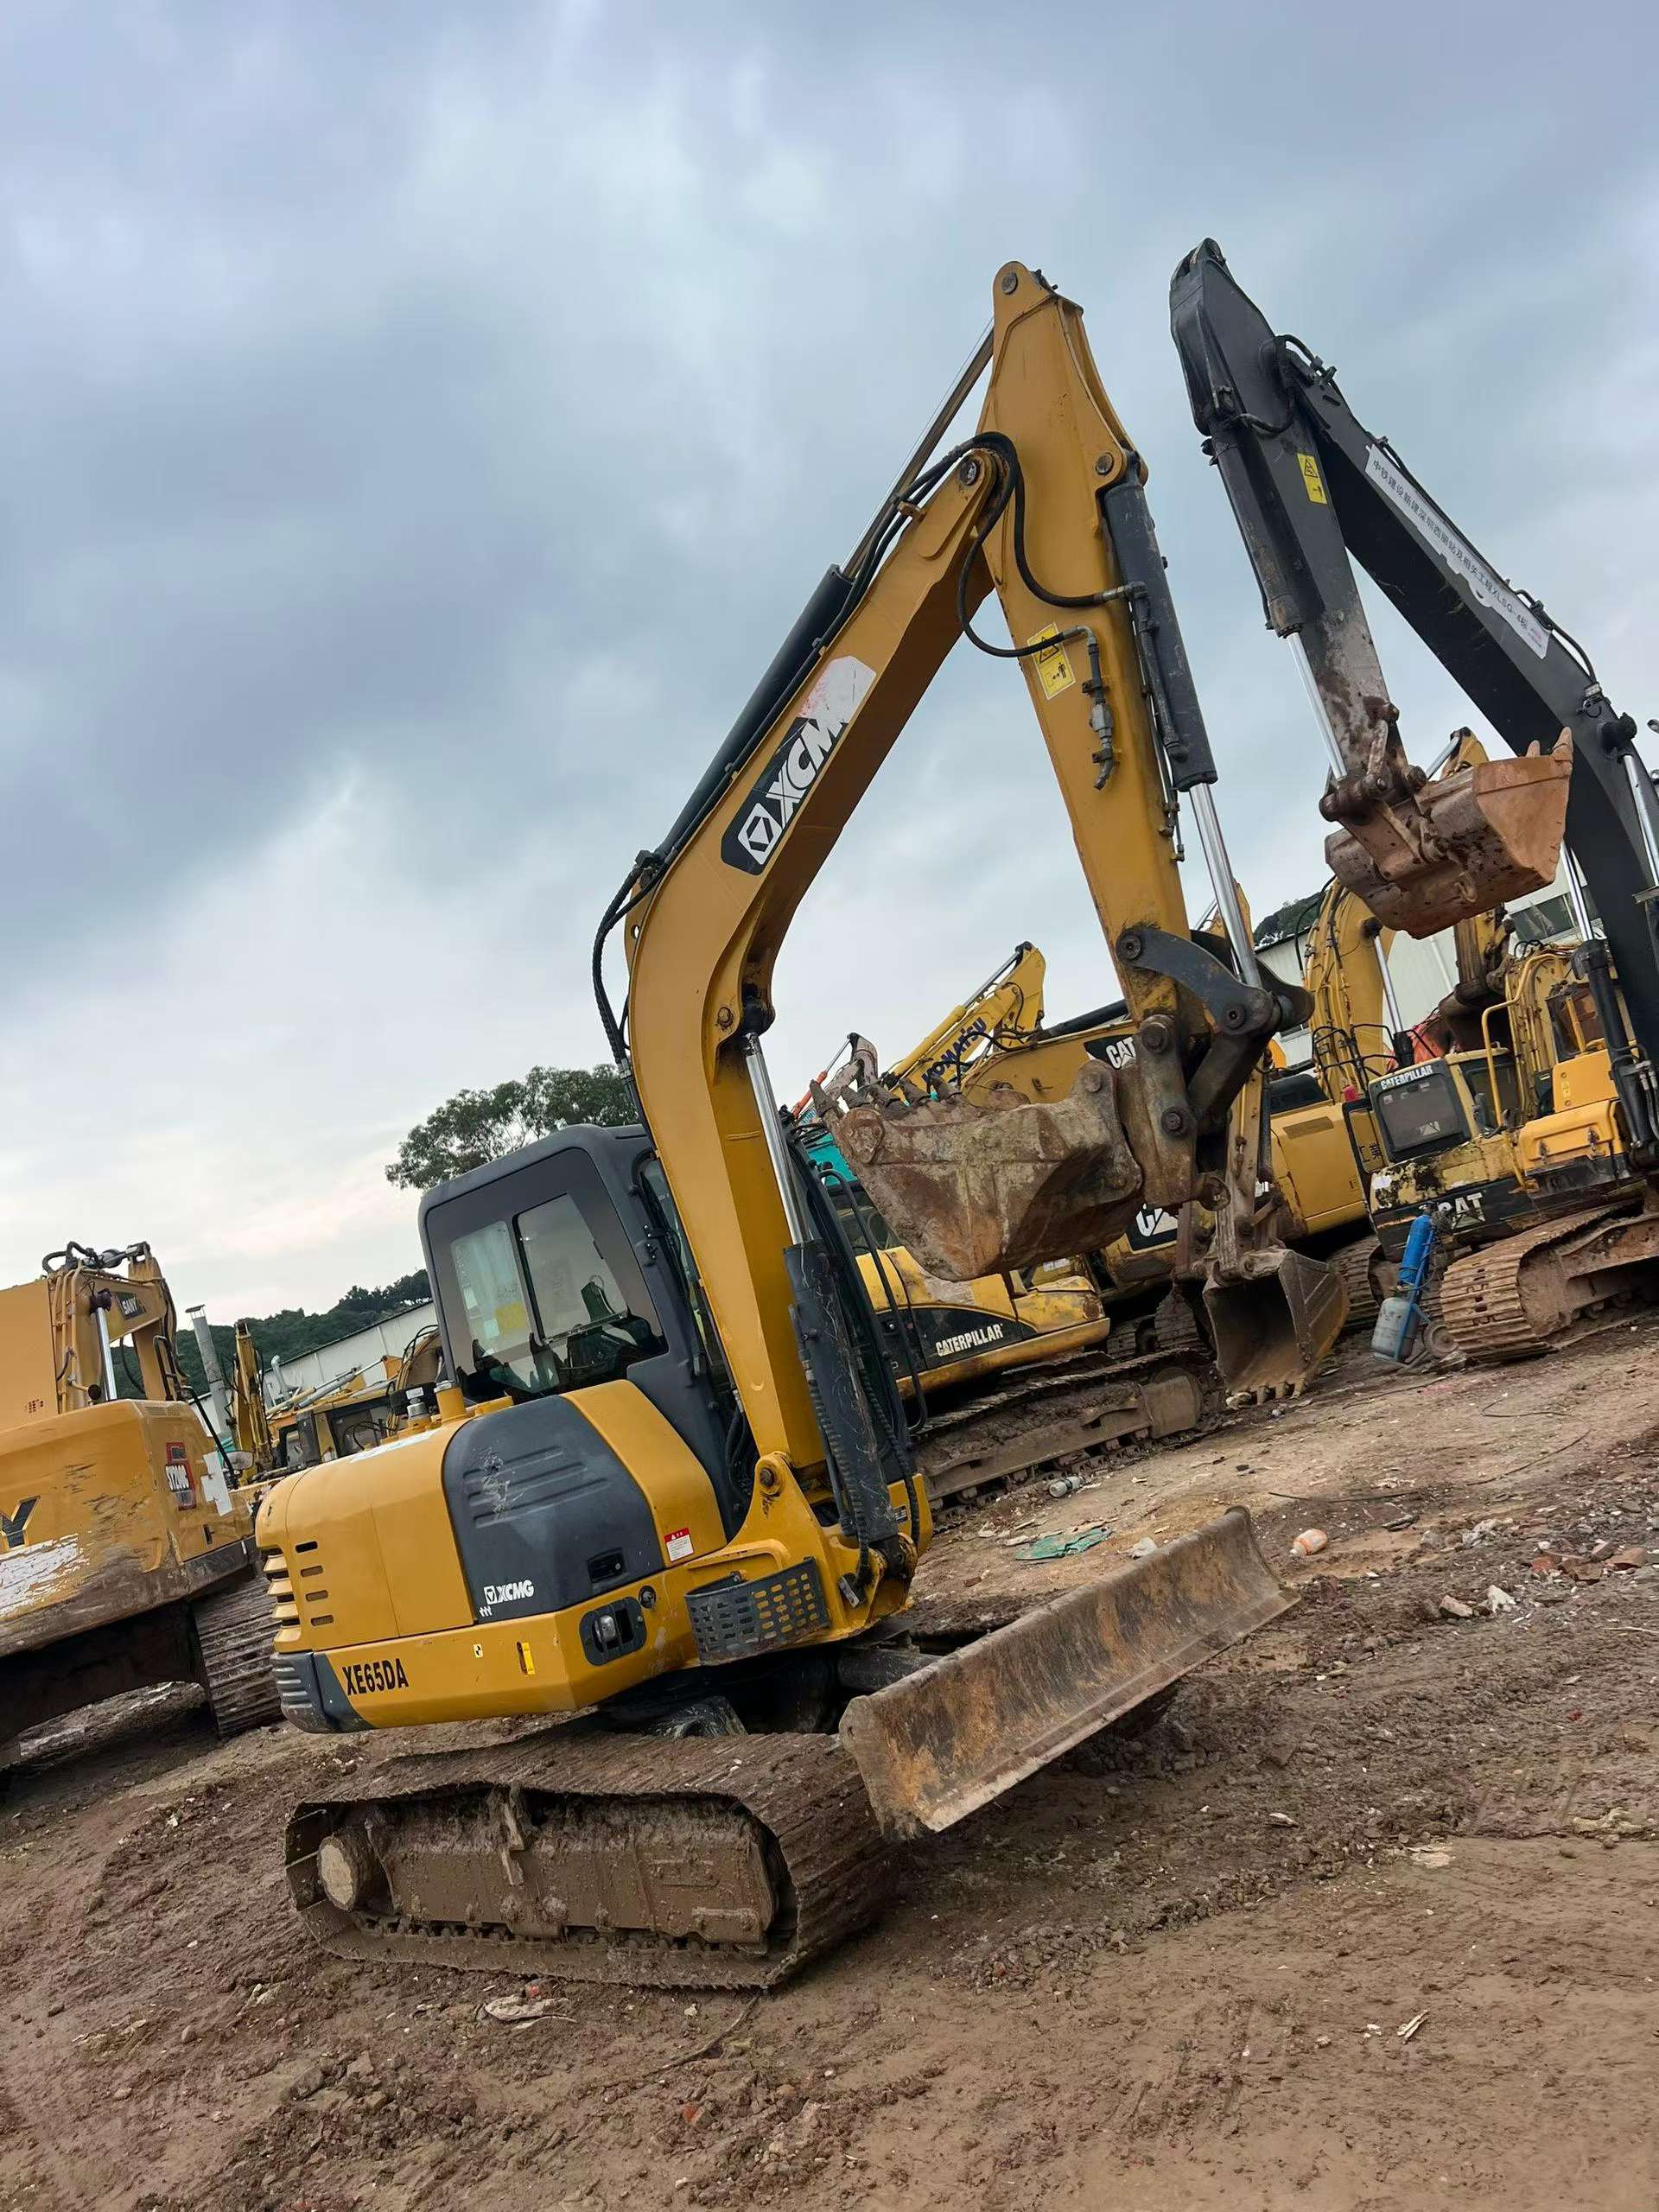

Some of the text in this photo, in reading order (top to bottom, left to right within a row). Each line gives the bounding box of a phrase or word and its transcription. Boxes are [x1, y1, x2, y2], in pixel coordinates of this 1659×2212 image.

[1106, 1036, 1137, 1069] CAT
[1380, 1065, 1433, 1090] CATERPILLAR
[935, 1324, 1004, 1357] CATERPILLAR
[495, 1580, 535, 1604] XCMG
[342, 1658, 409, 1695] XE65DA
